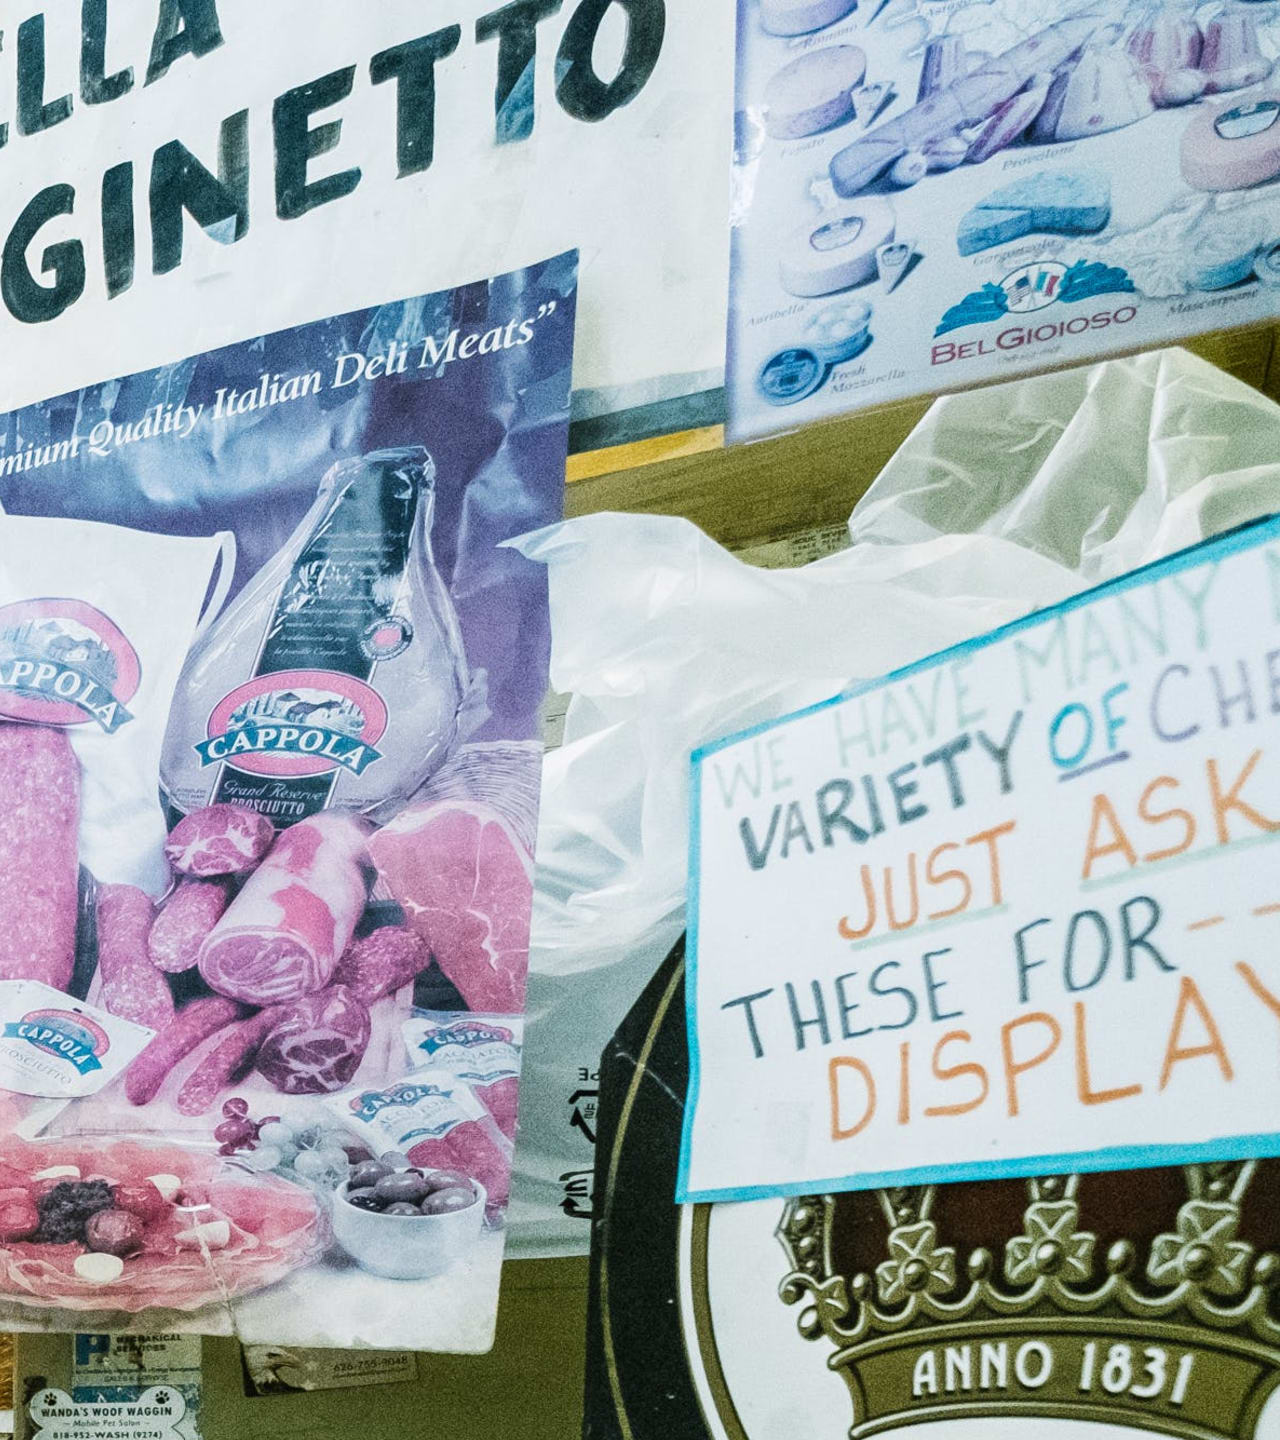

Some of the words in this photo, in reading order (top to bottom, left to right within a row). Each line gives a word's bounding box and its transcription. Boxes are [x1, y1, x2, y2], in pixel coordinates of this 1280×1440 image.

[88, 403, 206, 456] Quality
[212, 371, 322, 421] Italian
[332, 348, 408, 389] Deli
[713, 746, 794, 808] WE
[836, 651, 990, 770] HAVE
[1013, 560, 1223, 705] MANY
[208, 727, 367, 770] CAPPOLA
[224, 779, 267, 797] Grand
[273, 781, 327, 800] Reserve
[739, 709, 1024, 870] VARIETY
[1048, 681, 1129, 769] OF
[838, 820, 1016, 941] JUST
[1080, 748, 1280, 880] ASK
[17, 1024, 91, 1066] CAPPOLA
[721, 947, 964, 1059] THESE
[41, 1406, 89, 1418] WANDA'S
[92, 1407, 124, 1417] WOOF
[127, 1406, 173, 1417] WAGGIN
[911, 1340, 1054, 1397] ANNO
[1078, 1340, 1197, 1406] 1831
